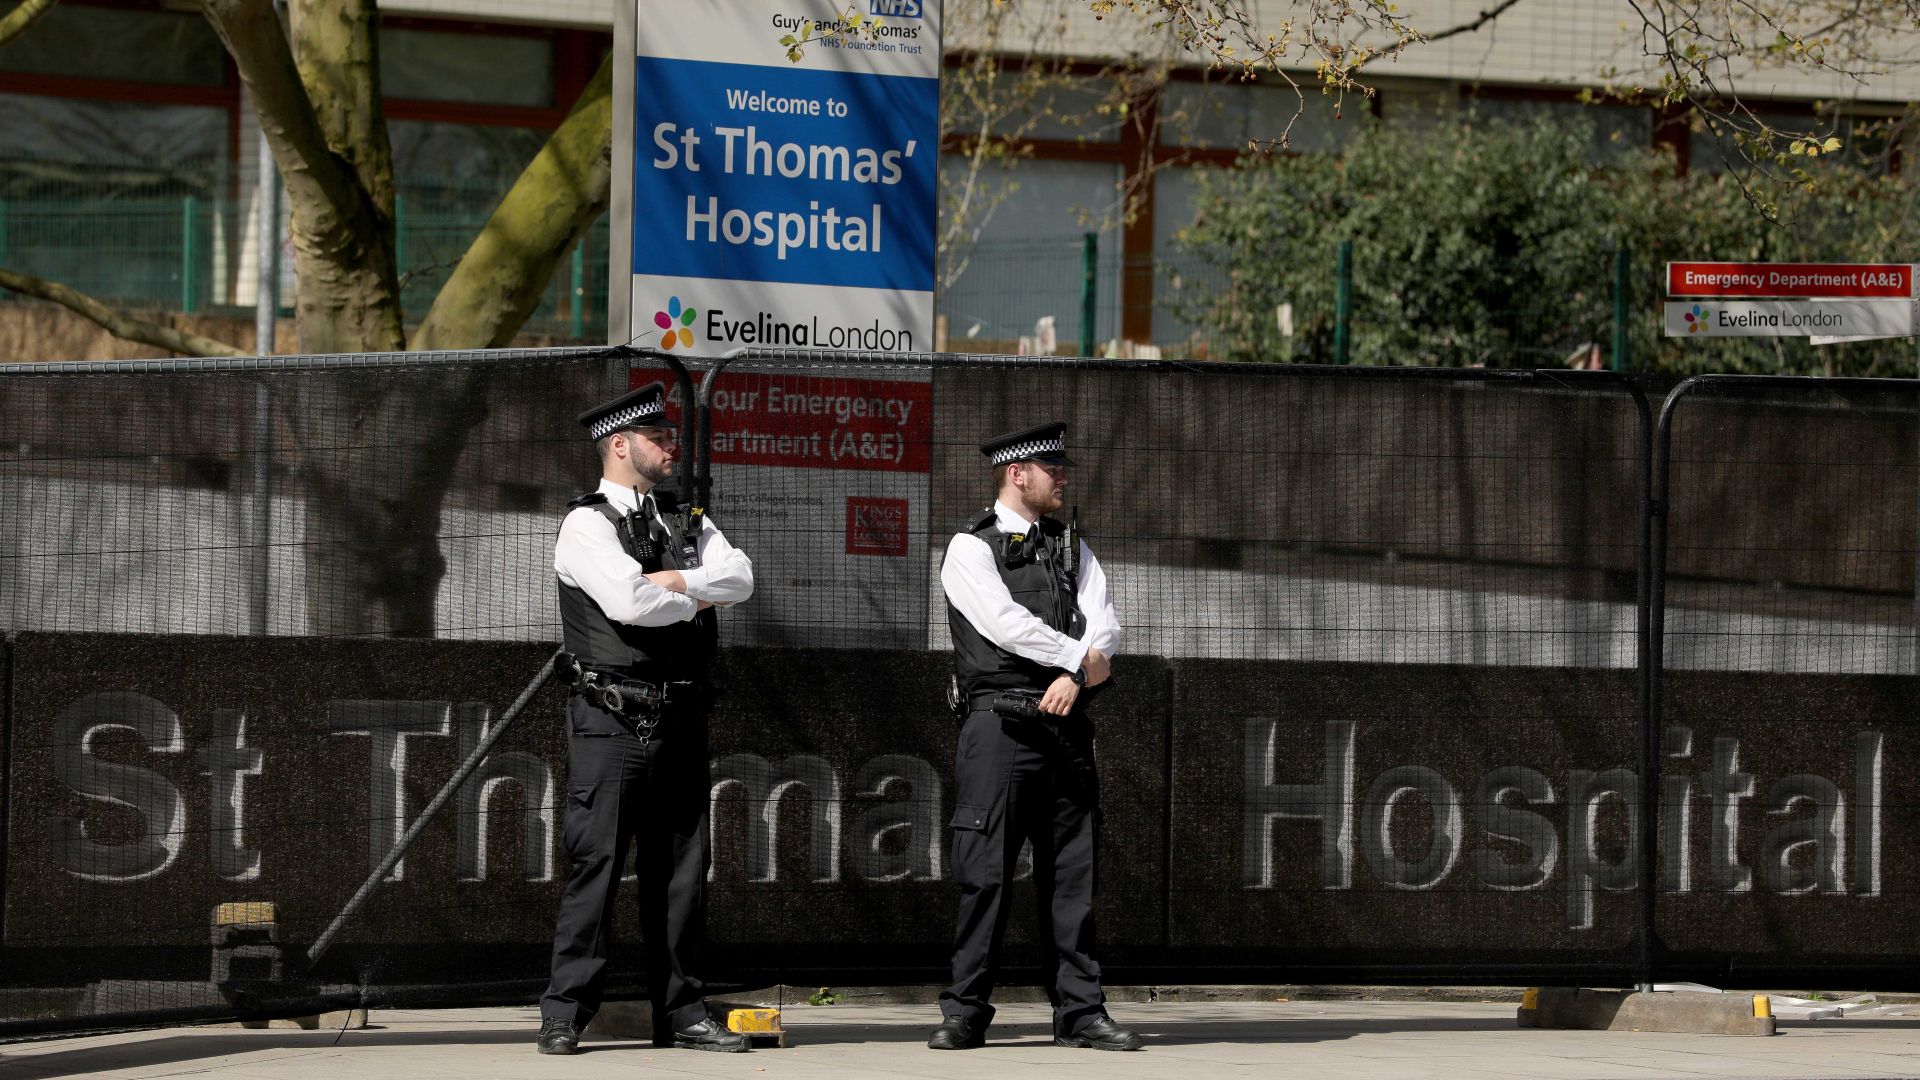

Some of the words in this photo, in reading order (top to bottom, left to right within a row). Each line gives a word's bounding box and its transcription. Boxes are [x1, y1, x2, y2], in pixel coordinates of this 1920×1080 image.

[871, 0, 921, 17] NHS
[863, 21, 922, 39] Tomas'
[820, 38, 840, 49] NHS
[843, 40, 896, 53] oundation
[898, 43, 922, 55] Trust
[726, 88, 820, 117] Welcome
[826, 97, 848, 118] to
[653, 122, 700, 172] St
[715, 125, 917, 185] Thomas'
[686, 195, 882, 260] Hospital
[1685, 271, 1765, 288] Emergency
[1769, 272, 1857, 288] Department
[1860, 271, 1903, 288] (A&E)
[1718, 311, 1778, 327] Evelina
[1782, 310, 1842, 327] London
[767, 386, 913, 425] Emergency
[829, 430, 904, 464] (A&E)
[46, 691, 263, 881] St
[1244, 717, 1884, 930] Hospital
